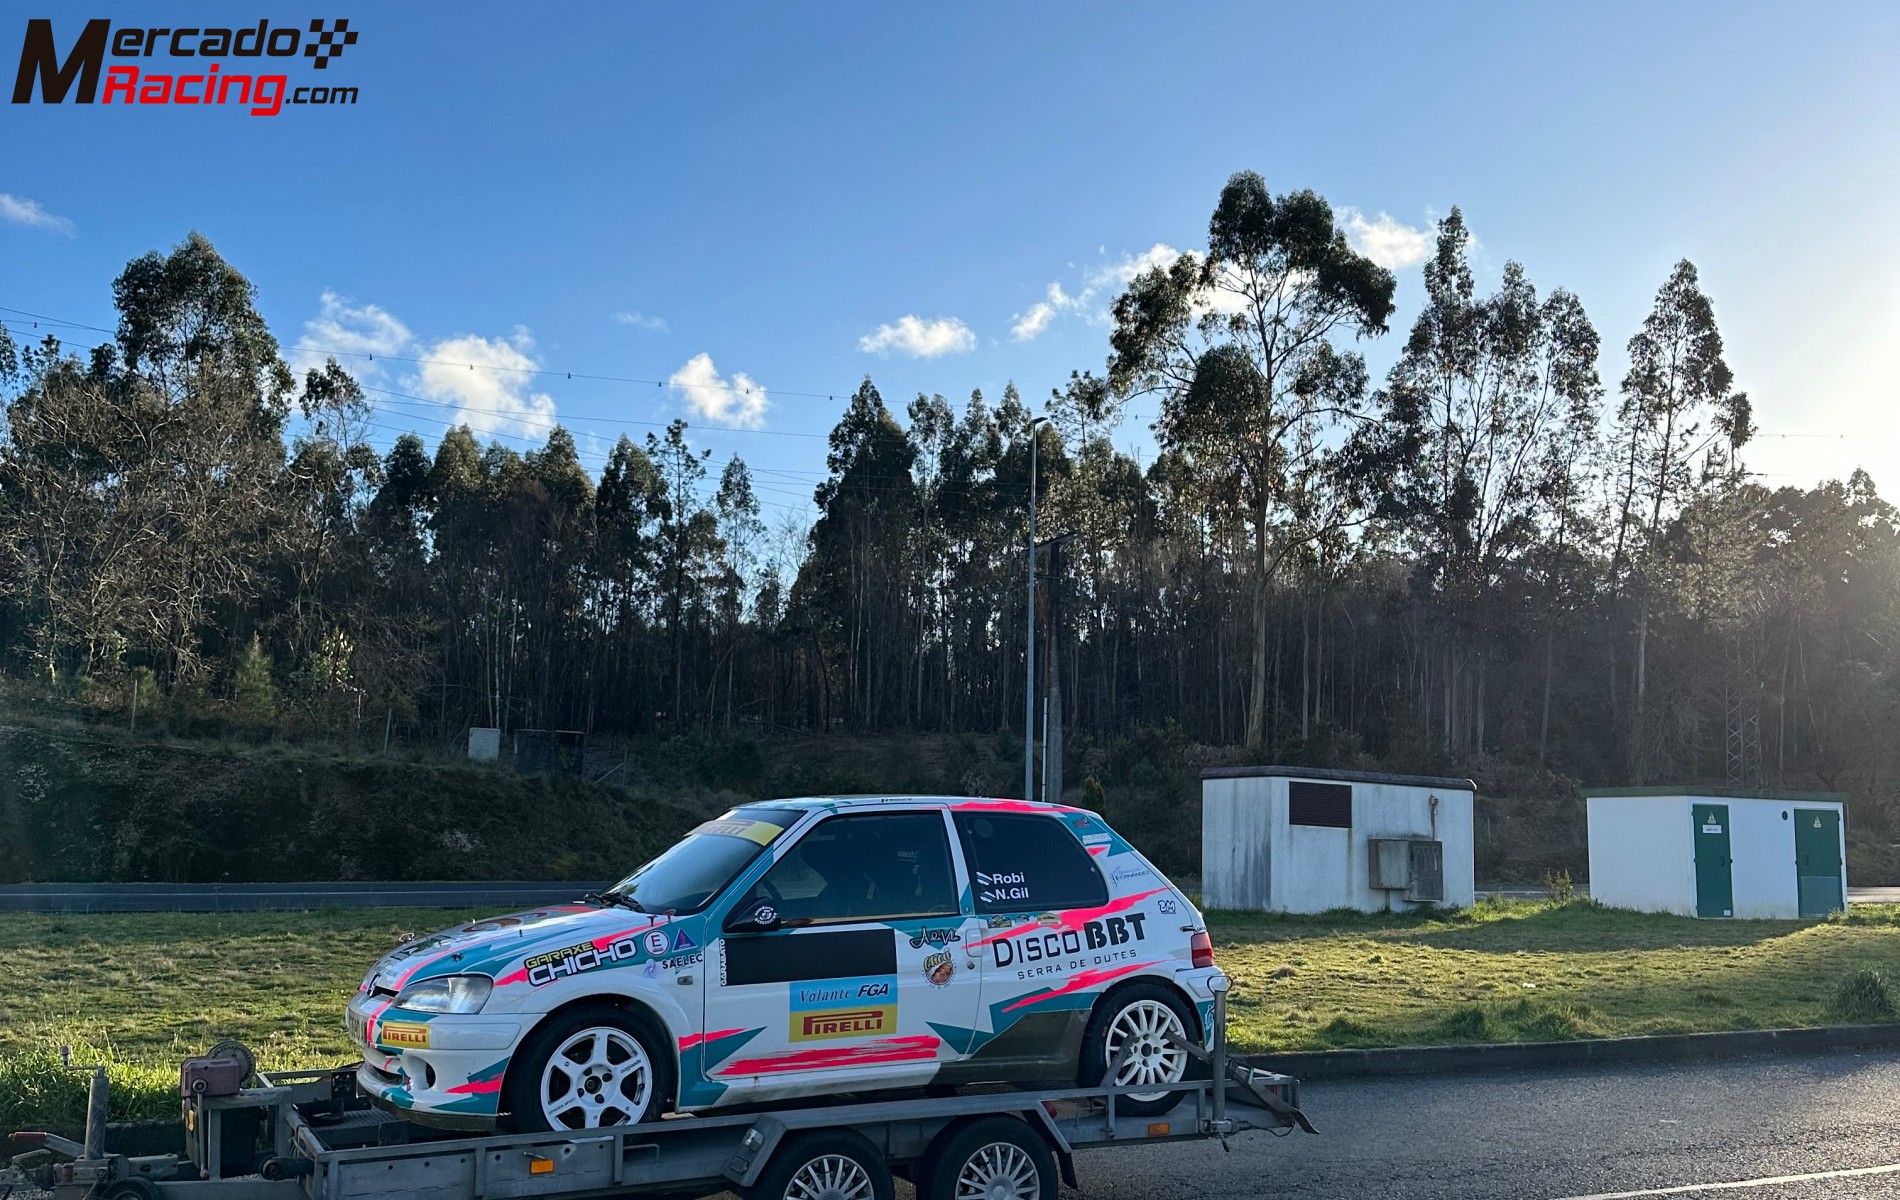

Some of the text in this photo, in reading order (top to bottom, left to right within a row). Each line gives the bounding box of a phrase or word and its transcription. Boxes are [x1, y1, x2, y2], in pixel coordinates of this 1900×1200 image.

[992, 871, 1025, 885] Robi
[995, 887, 1029, 900] N.Gil
[992, 912, 1146, 968] DISCO BBT
[525, 942, 594, 969] GARAXE
[528, 939, 637, 987] CHICHO
[661, 953, 703, 969] SAELEC
[1017, 949, 1137, 980] SERRA DE OUTES
[800, 983, 889, 1003] Volante FGA
[383, 1025, 427, 1042] PIRELLI
[803, 1010, 883, 1036] PIRELLI
